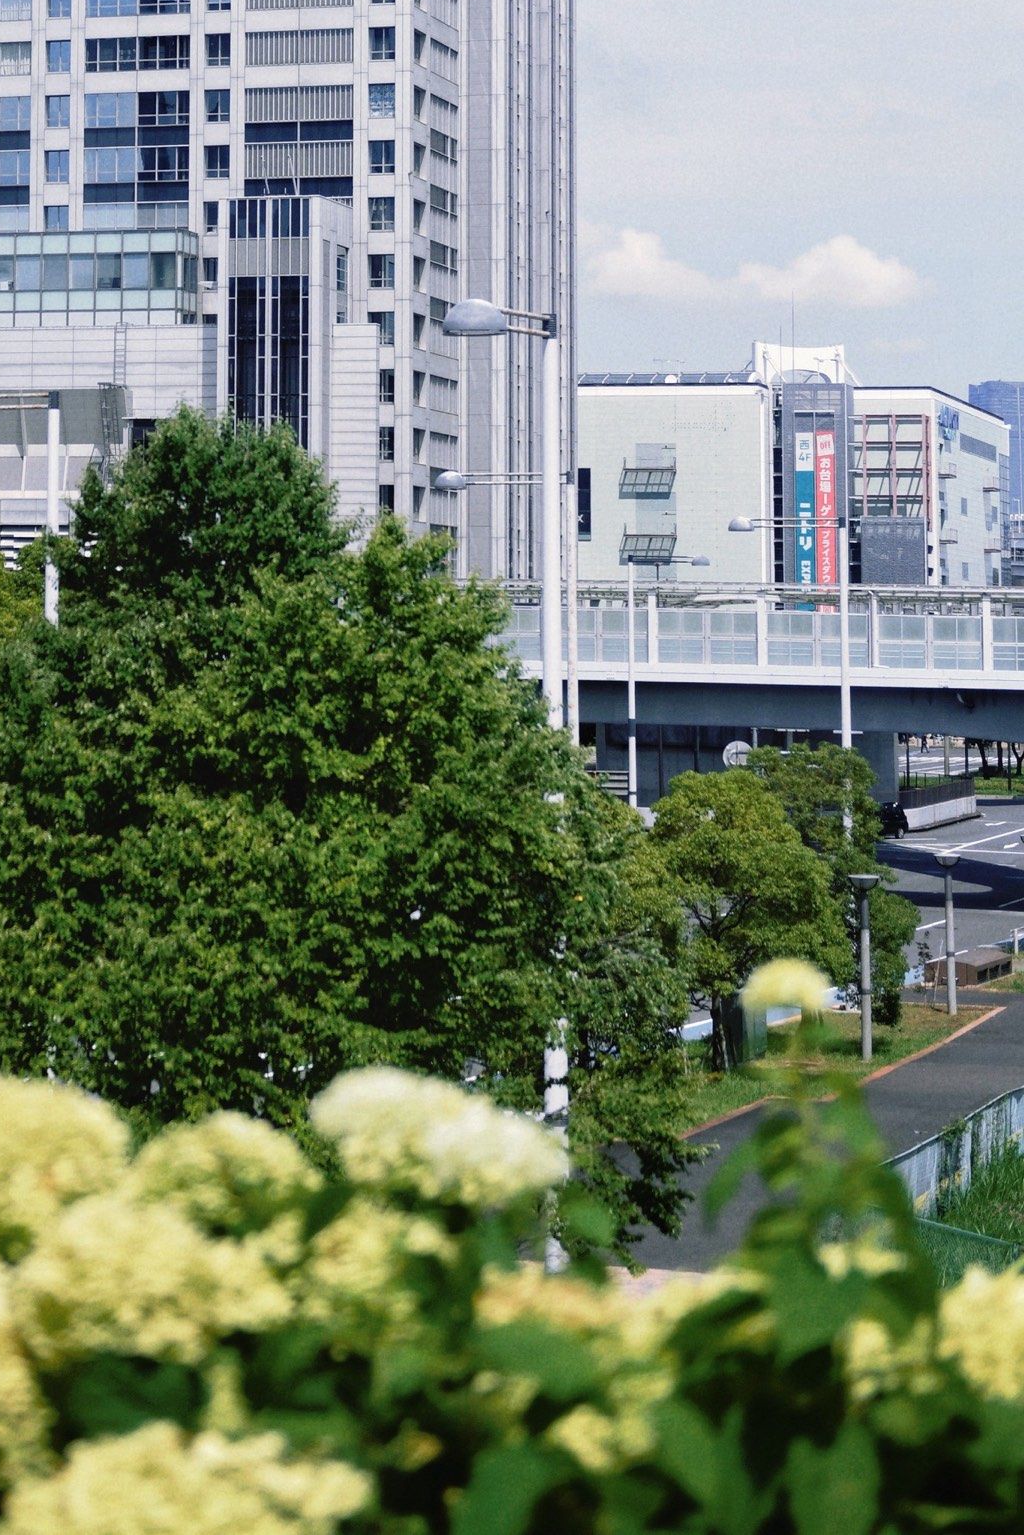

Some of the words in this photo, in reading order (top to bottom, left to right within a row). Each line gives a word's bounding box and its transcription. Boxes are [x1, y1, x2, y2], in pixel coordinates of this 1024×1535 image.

[798, 452, 811, 462] 4F
[799, 502, 813, 551] ニトリ
